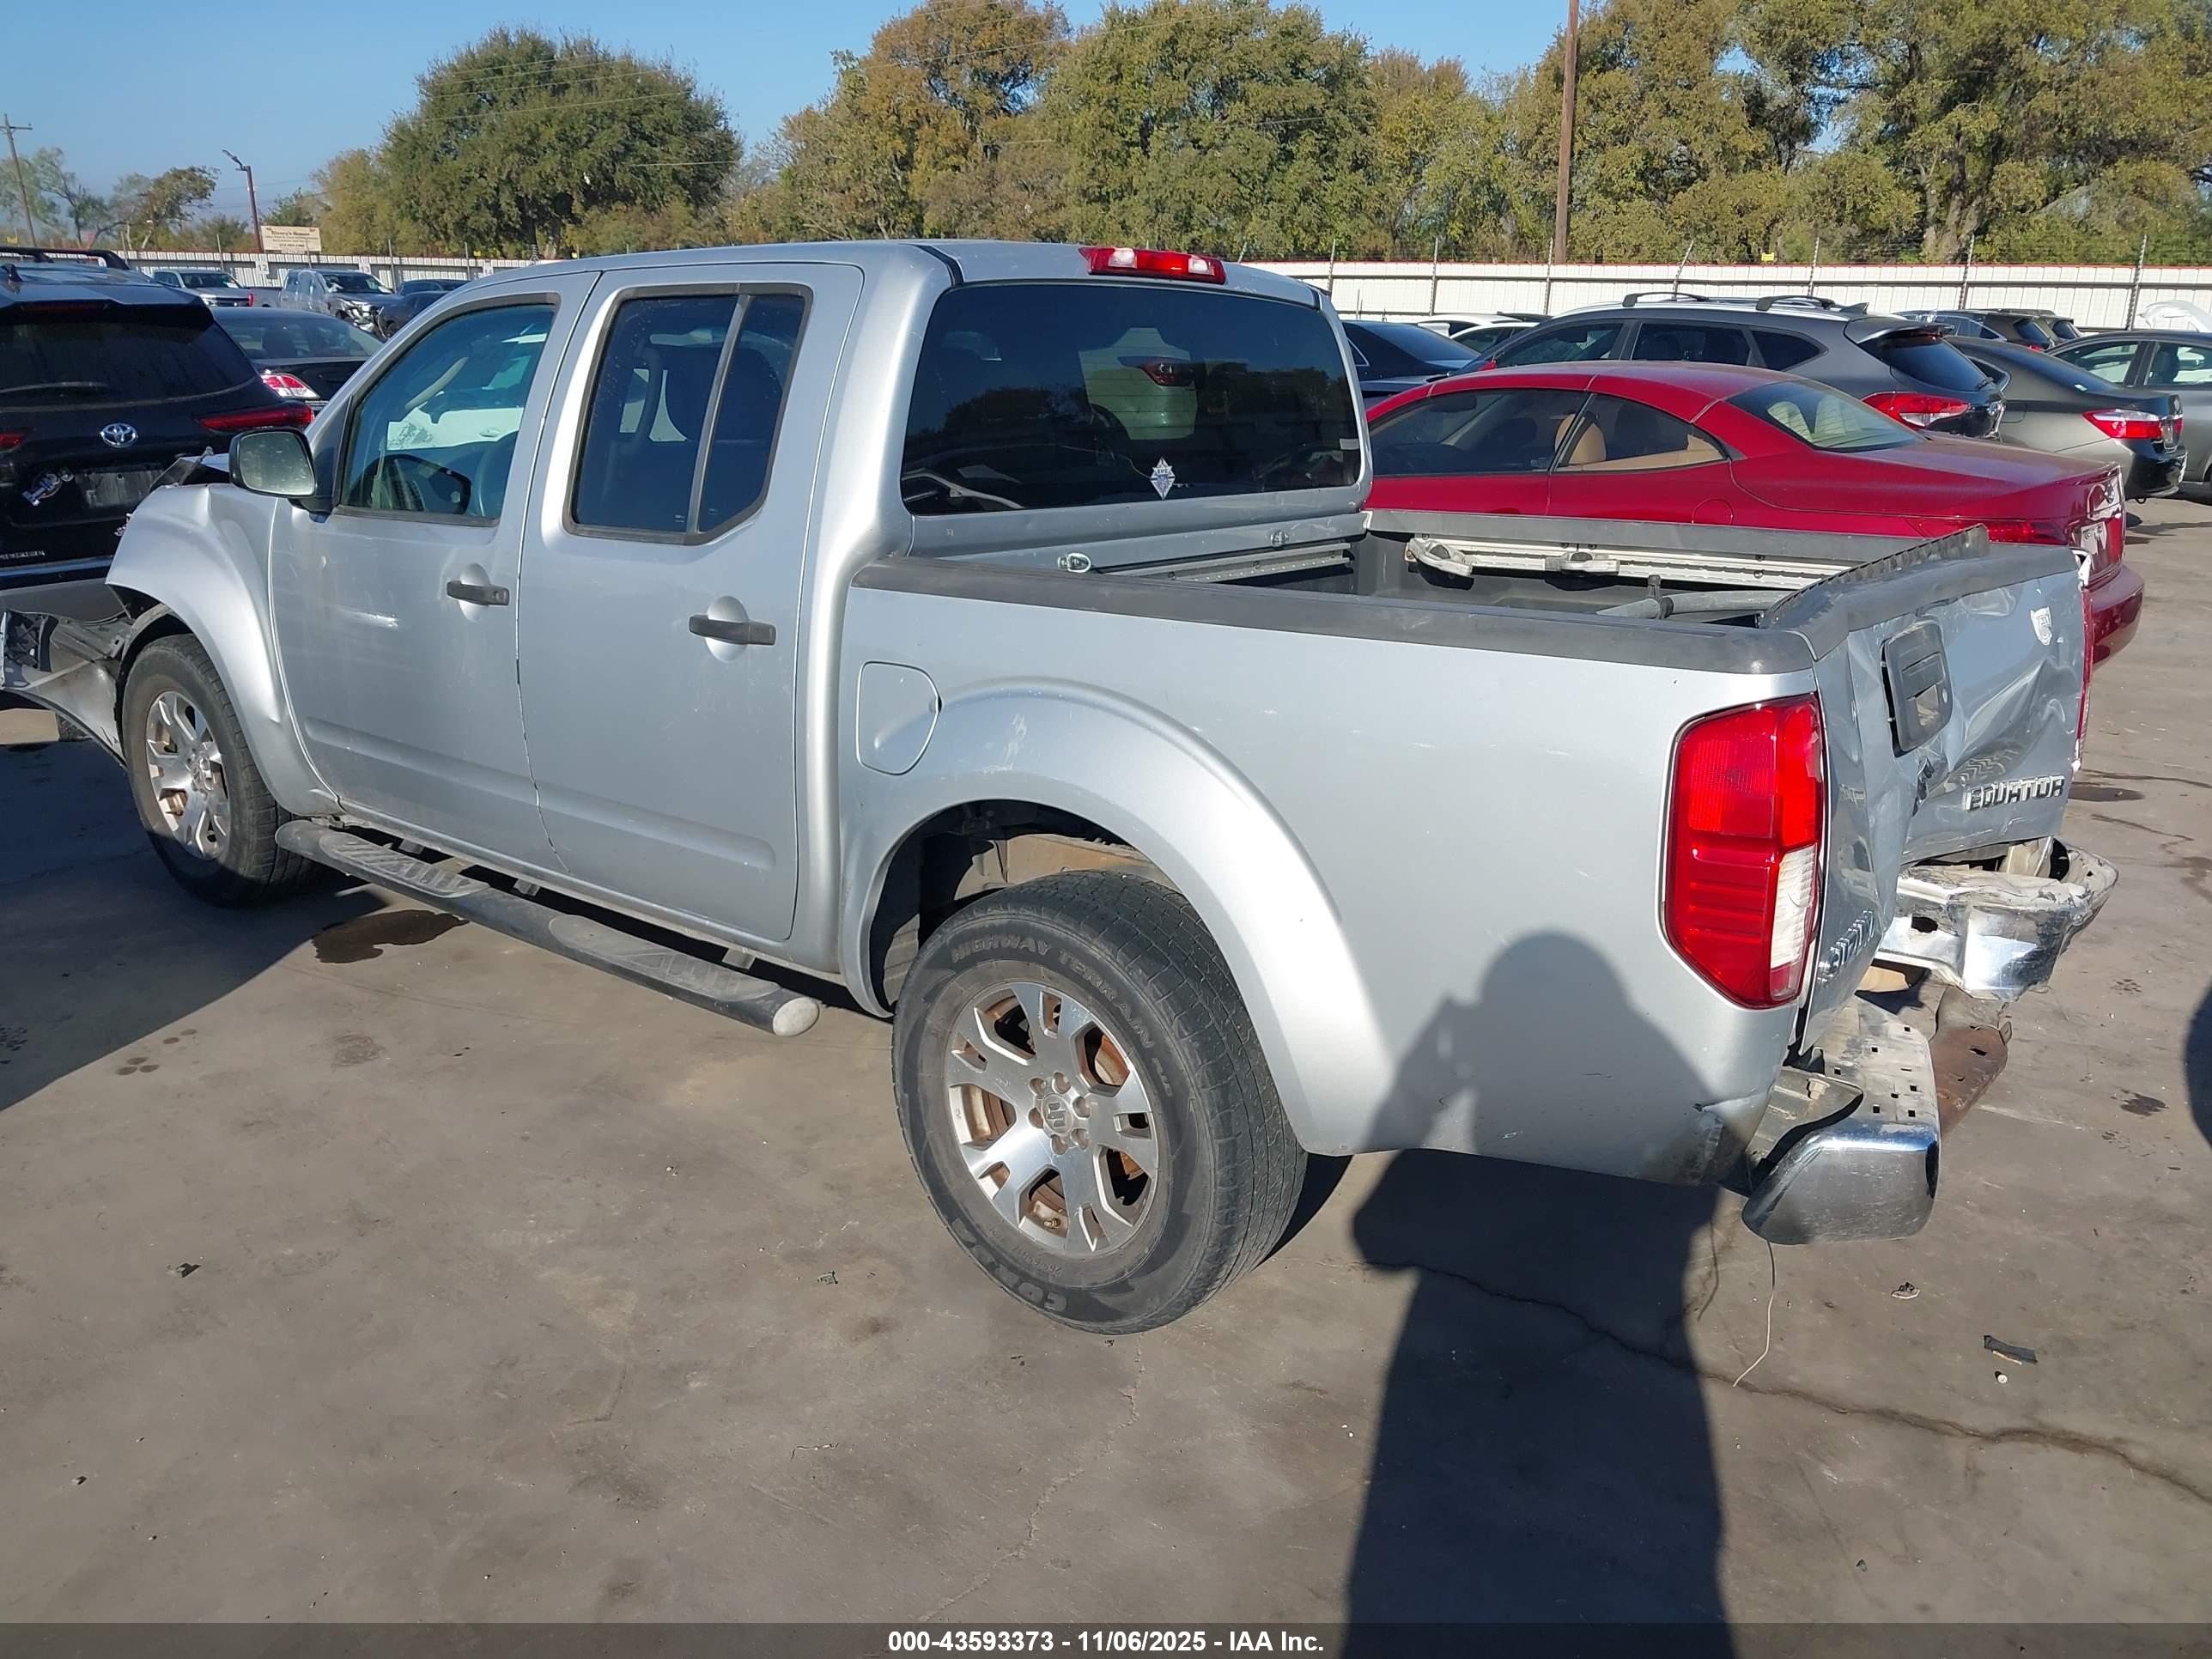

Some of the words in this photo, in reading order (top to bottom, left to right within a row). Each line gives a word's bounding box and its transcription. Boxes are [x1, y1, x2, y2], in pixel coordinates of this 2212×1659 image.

[1961, 775, 2065, 811] EQUATOR
[951, 934, 1051, 963] HIGHWAY
[1058, 950, 1154, 1049] TERRAIN
